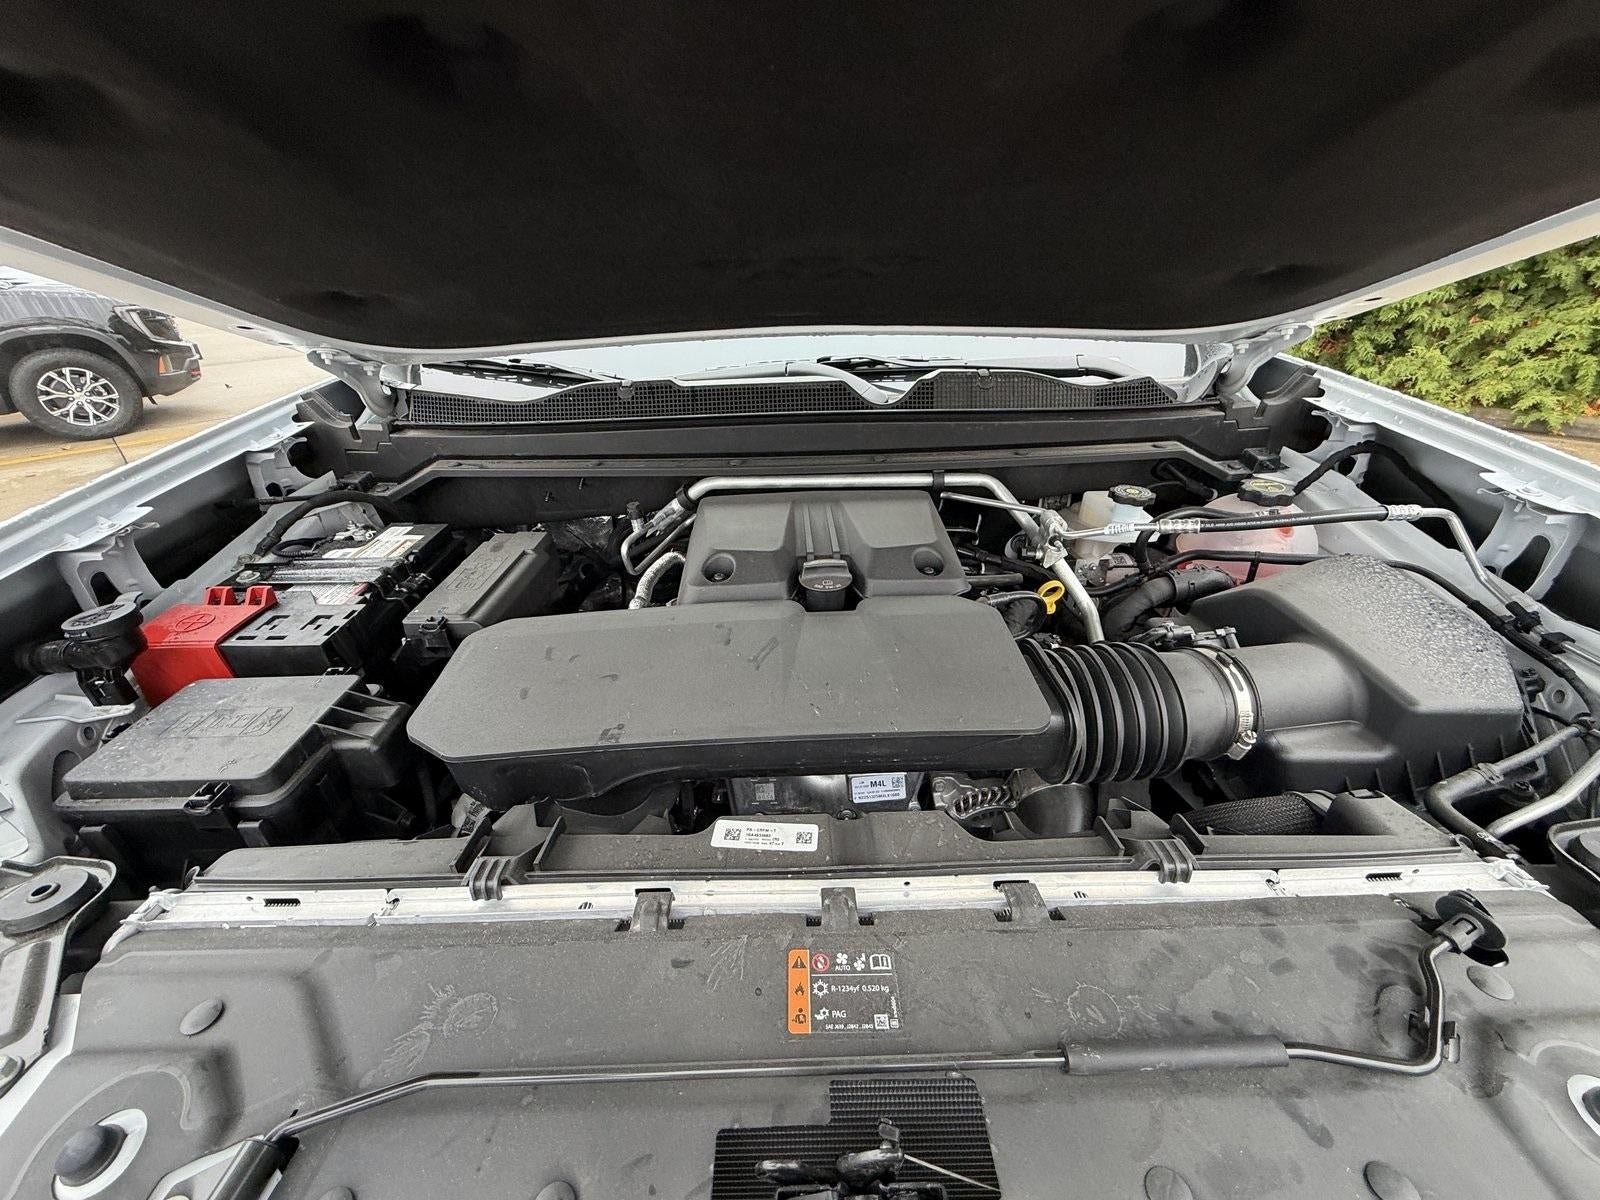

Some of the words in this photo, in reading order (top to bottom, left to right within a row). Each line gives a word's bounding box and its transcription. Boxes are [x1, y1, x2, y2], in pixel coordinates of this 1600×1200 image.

[870, 780, 886, 788] M4L
[831, 985, 860, 993] R-1234yf
[881, 984, 889, 993] kg
[831, 1010, 847, 1018] PAG
